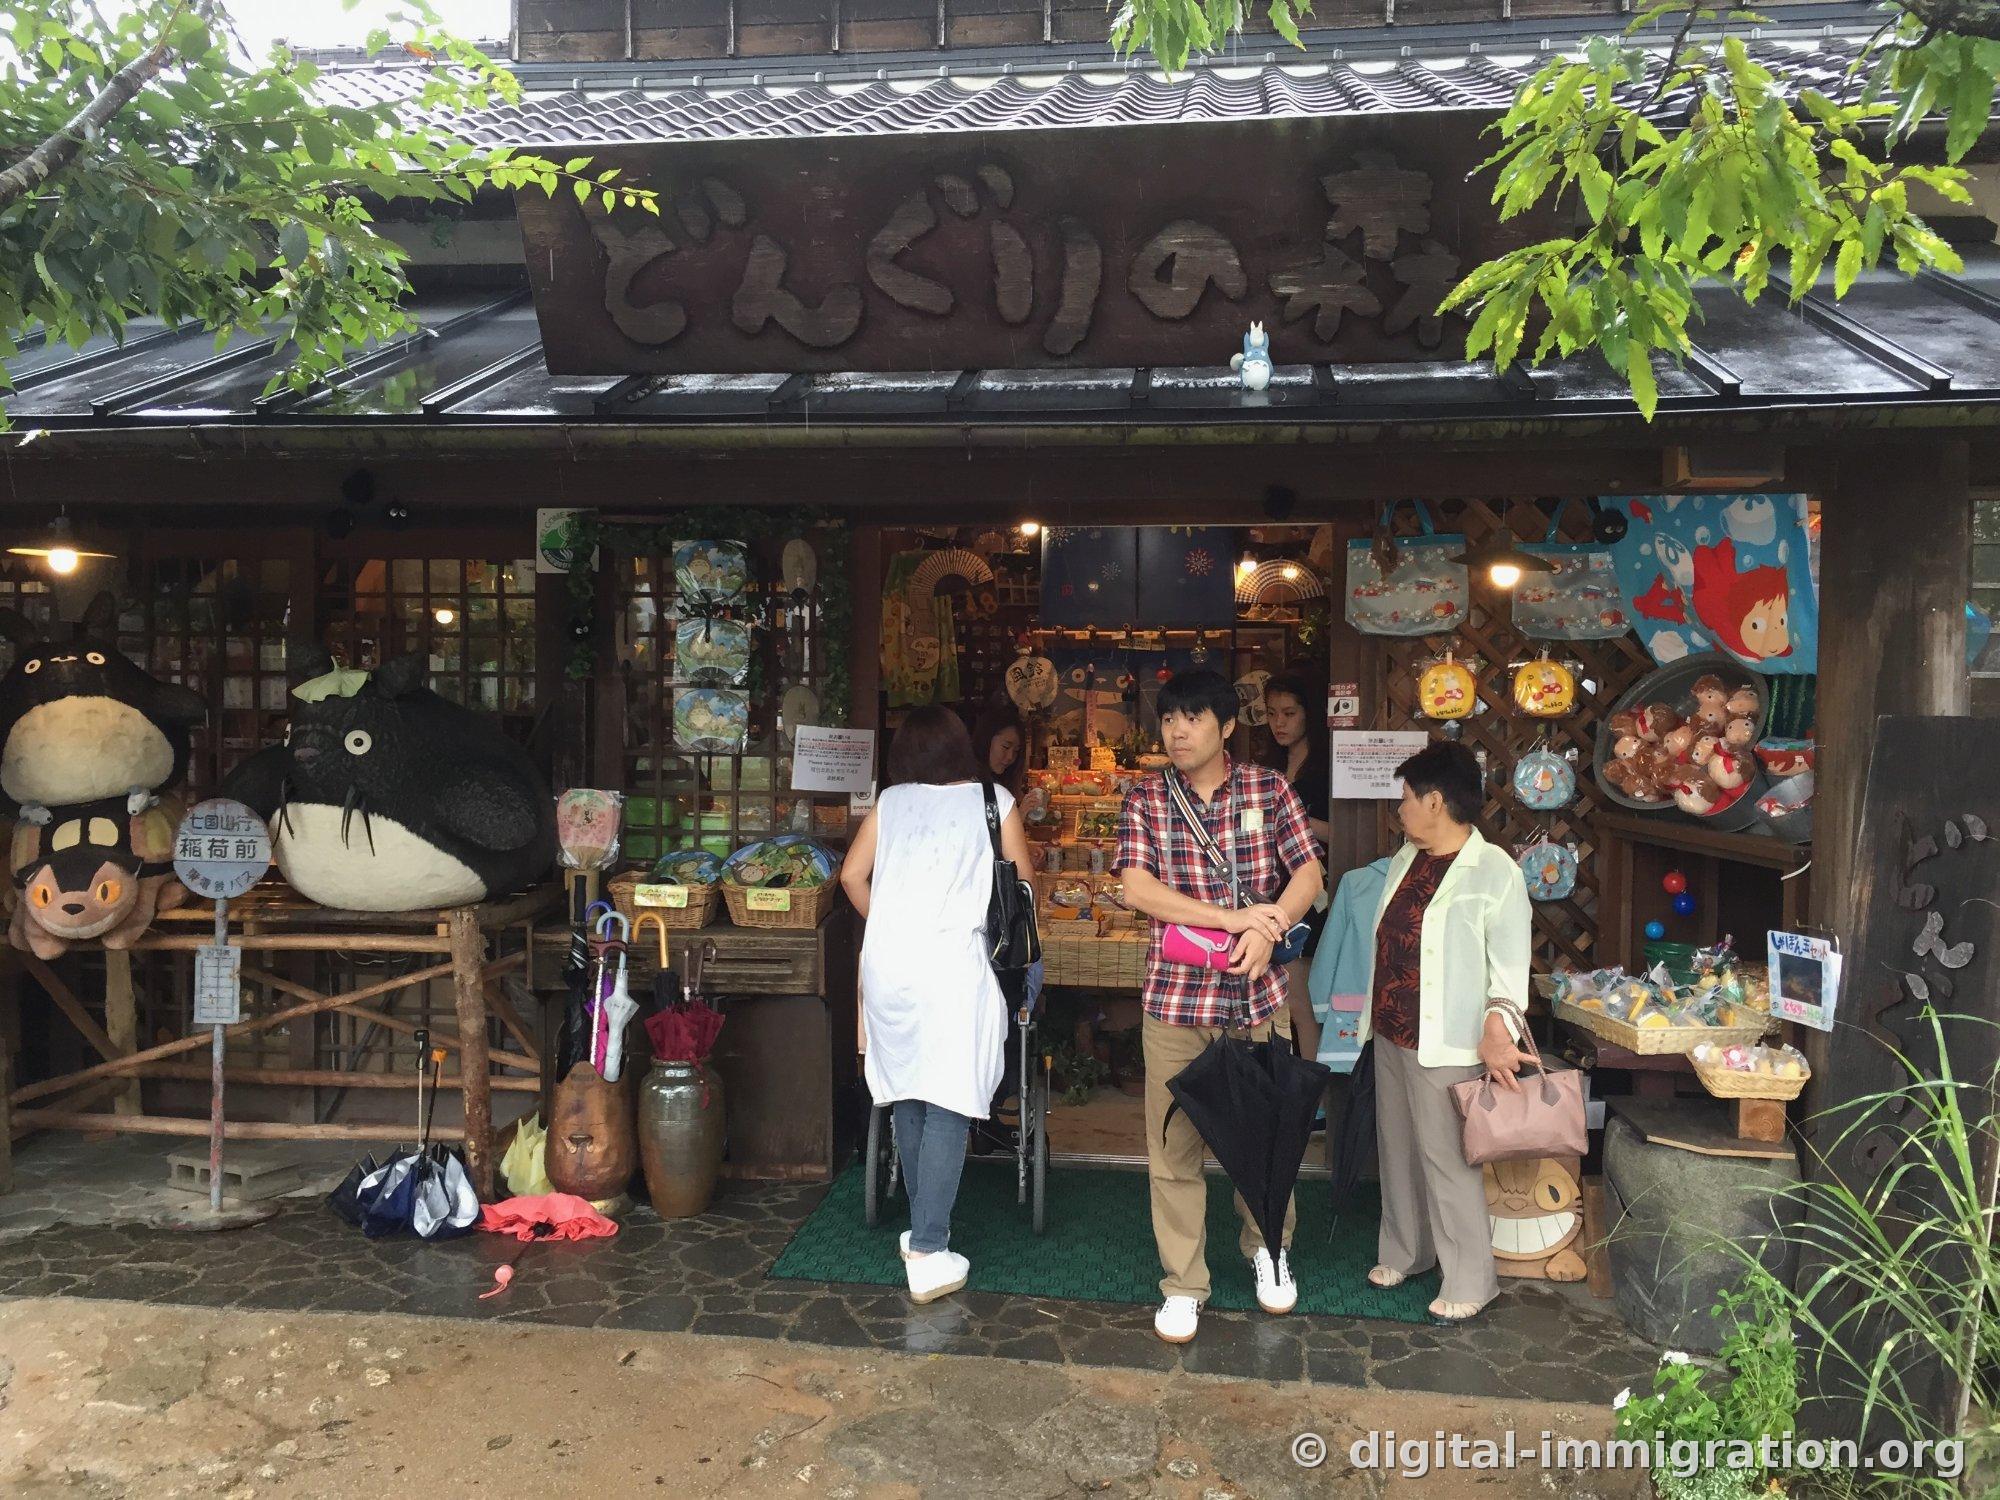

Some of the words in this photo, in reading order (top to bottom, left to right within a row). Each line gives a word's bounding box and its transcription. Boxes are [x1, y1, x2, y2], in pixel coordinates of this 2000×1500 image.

[582, 148, 1463, 356] どんぐりの森
[180, 838, 258, 859] 稲荷前
